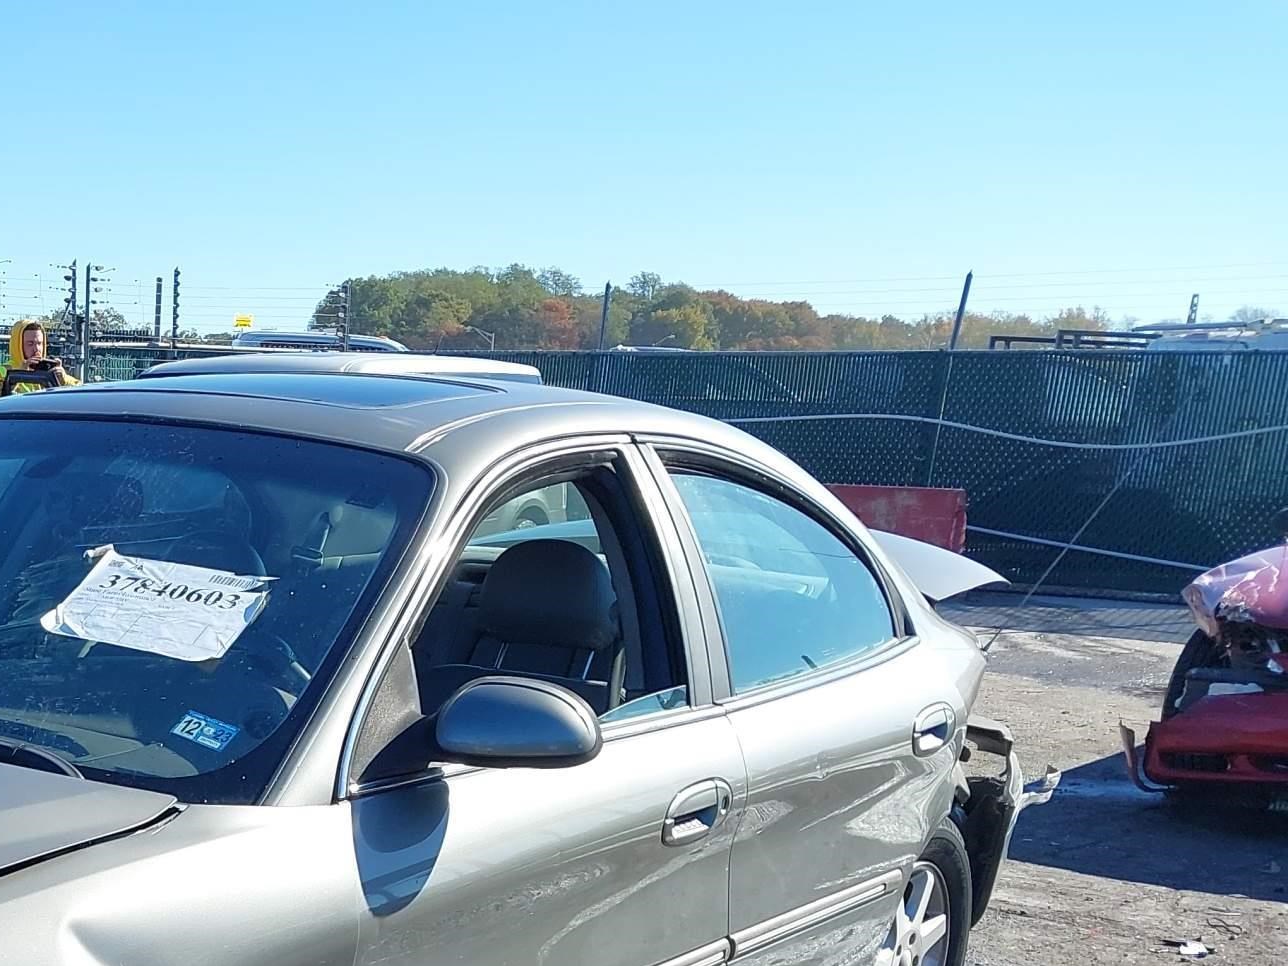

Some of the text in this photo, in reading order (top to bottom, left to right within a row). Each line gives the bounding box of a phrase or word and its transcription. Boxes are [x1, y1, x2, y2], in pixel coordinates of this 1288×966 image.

[99, 574, 241, 609] 37840603
[180, 718, 202, 736] 12
[213, 728, 233, 743] 23
